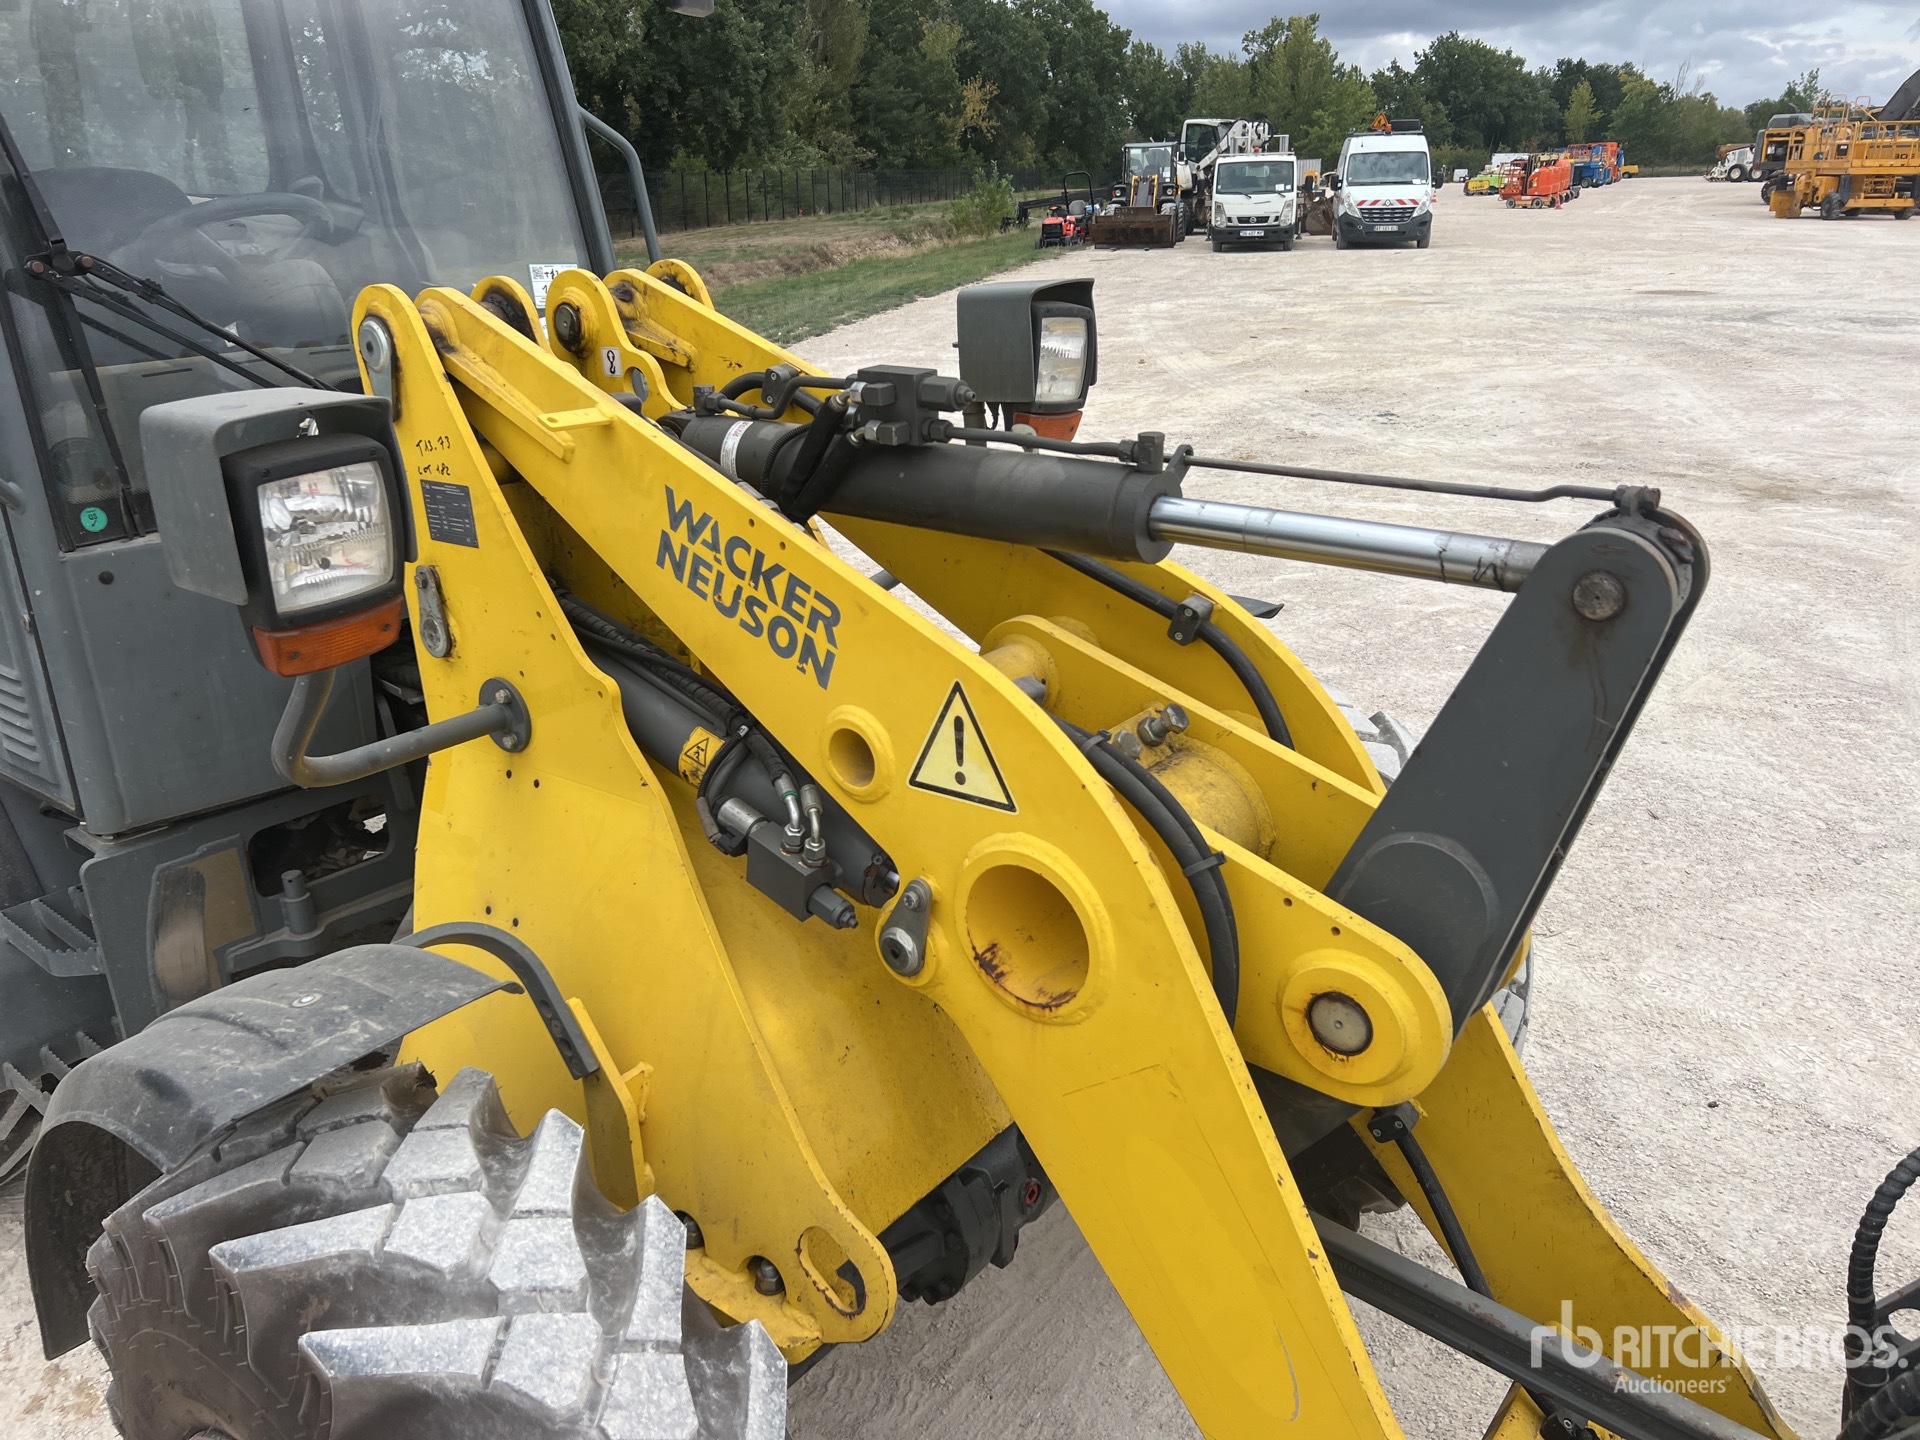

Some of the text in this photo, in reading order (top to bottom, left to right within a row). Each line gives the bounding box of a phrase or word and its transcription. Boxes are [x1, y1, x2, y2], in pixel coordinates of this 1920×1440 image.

[436, 463, 451, 476] 182
[656, 529, 837, 691] NEUSON
[664, 484, 841, 650] WACKER
